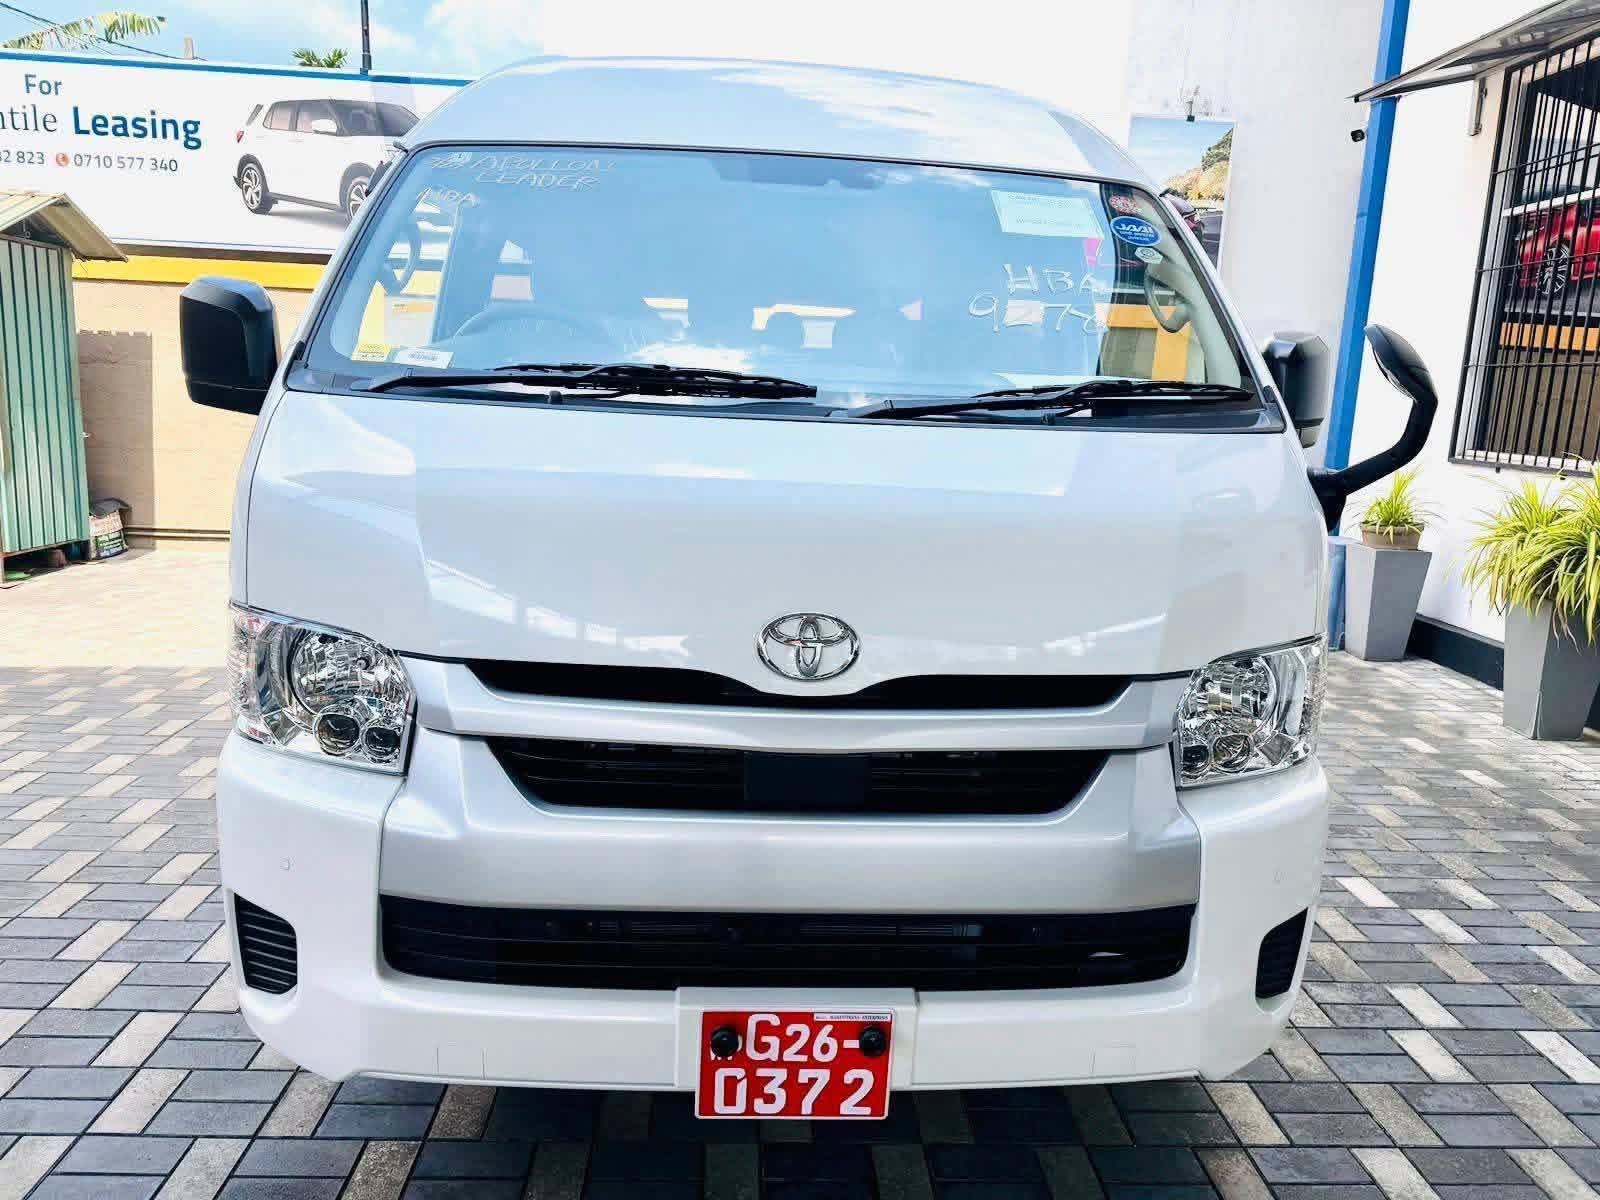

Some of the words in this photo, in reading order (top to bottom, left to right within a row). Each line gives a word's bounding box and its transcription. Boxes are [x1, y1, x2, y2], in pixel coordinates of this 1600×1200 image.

[24, 73, 62, 96] For
[72, 106, 201, 150] Leasing
[16, 150, 45, 165] 823
[73, 153, 113, 168] 0710
[116, 156, 145, 170] 577
[150, 158, 178, 172] 340
[713, 1067, 875, 1115] 0372
